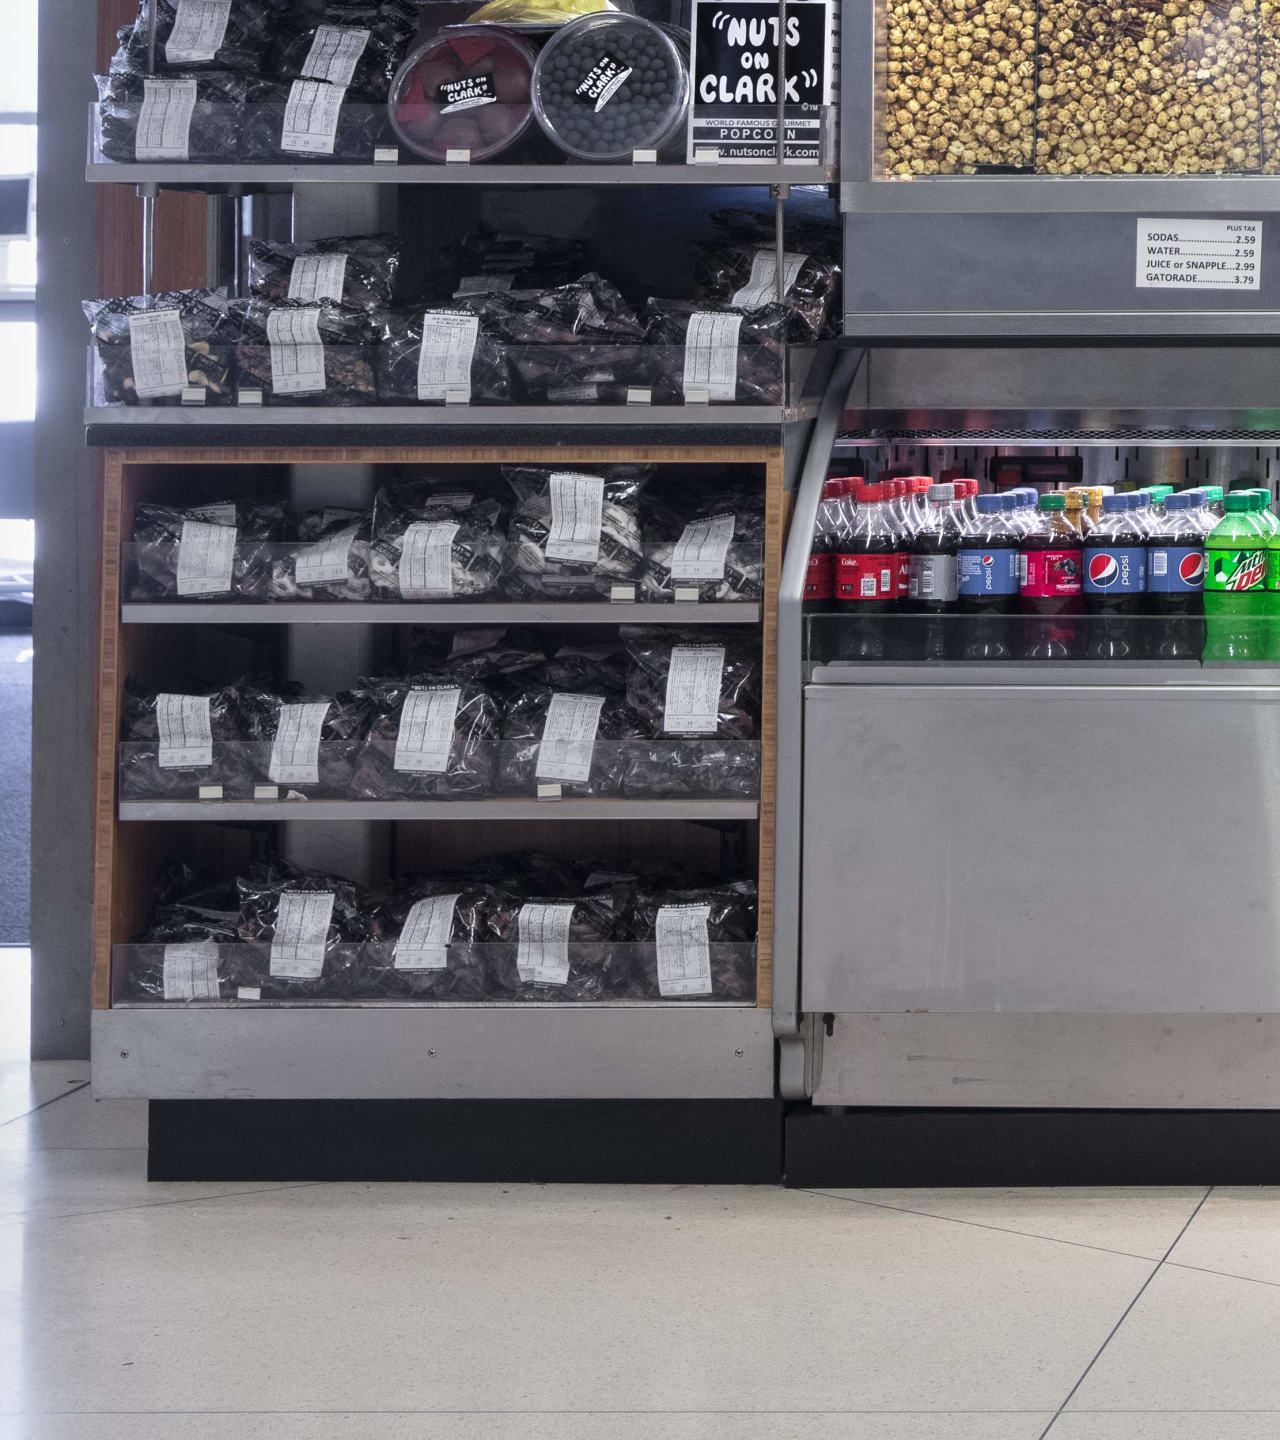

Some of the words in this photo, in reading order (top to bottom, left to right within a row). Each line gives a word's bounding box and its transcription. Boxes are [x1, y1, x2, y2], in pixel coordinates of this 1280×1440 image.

[741, 52, 769, 69] ON
[576, 69, 601, 95] "NUTS
[599, 57, 609, 67] ON
[588, 63, 617, 98] CLARK"
[441, 79, 473, 92] "NUTS
[448, 85, 487, 102] CLARK"
[1147, 260, 1171, 268] JUICE
[1121, 555, 1130, 586] pepsi
